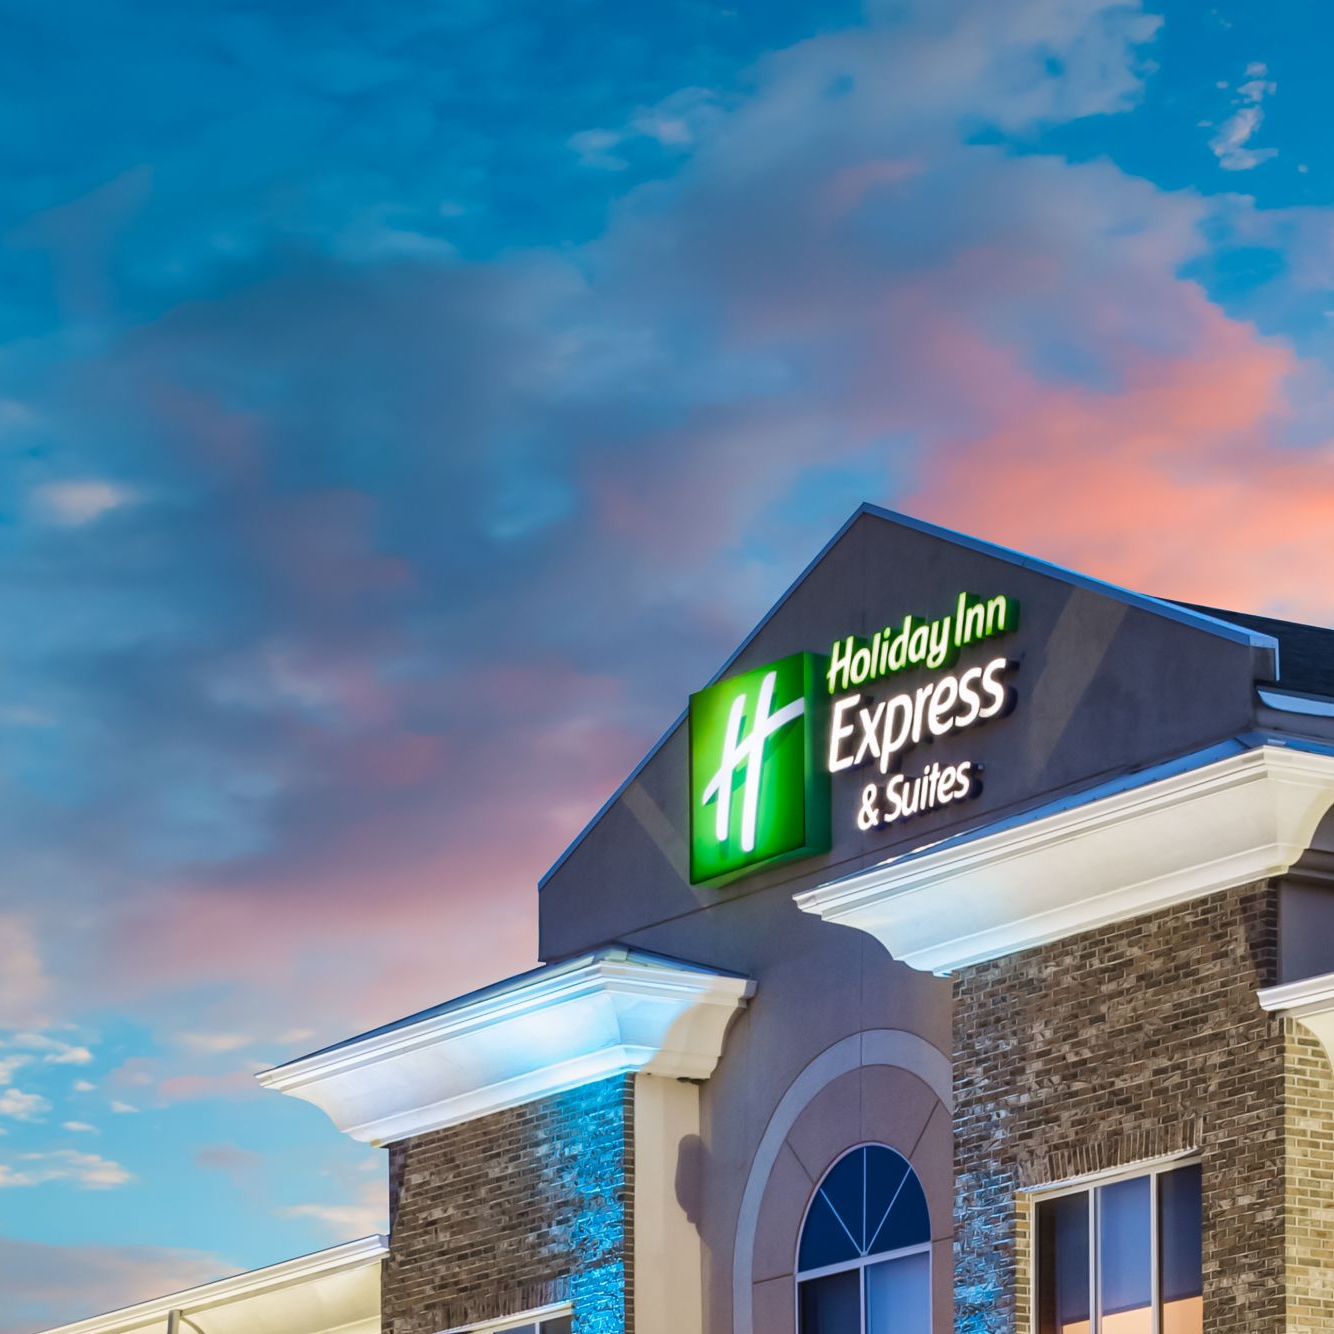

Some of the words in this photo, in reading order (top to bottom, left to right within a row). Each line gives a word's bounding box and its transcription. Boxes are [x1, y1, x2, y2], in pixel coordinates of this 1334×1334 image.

[827, 615, 951, 694] Holiday
[955, 592, 1007, 647] Inn
[828, 657, 1008, 774] Express
[857, 783, 879, 831] &
[884, 761, 971, 824] Suites
